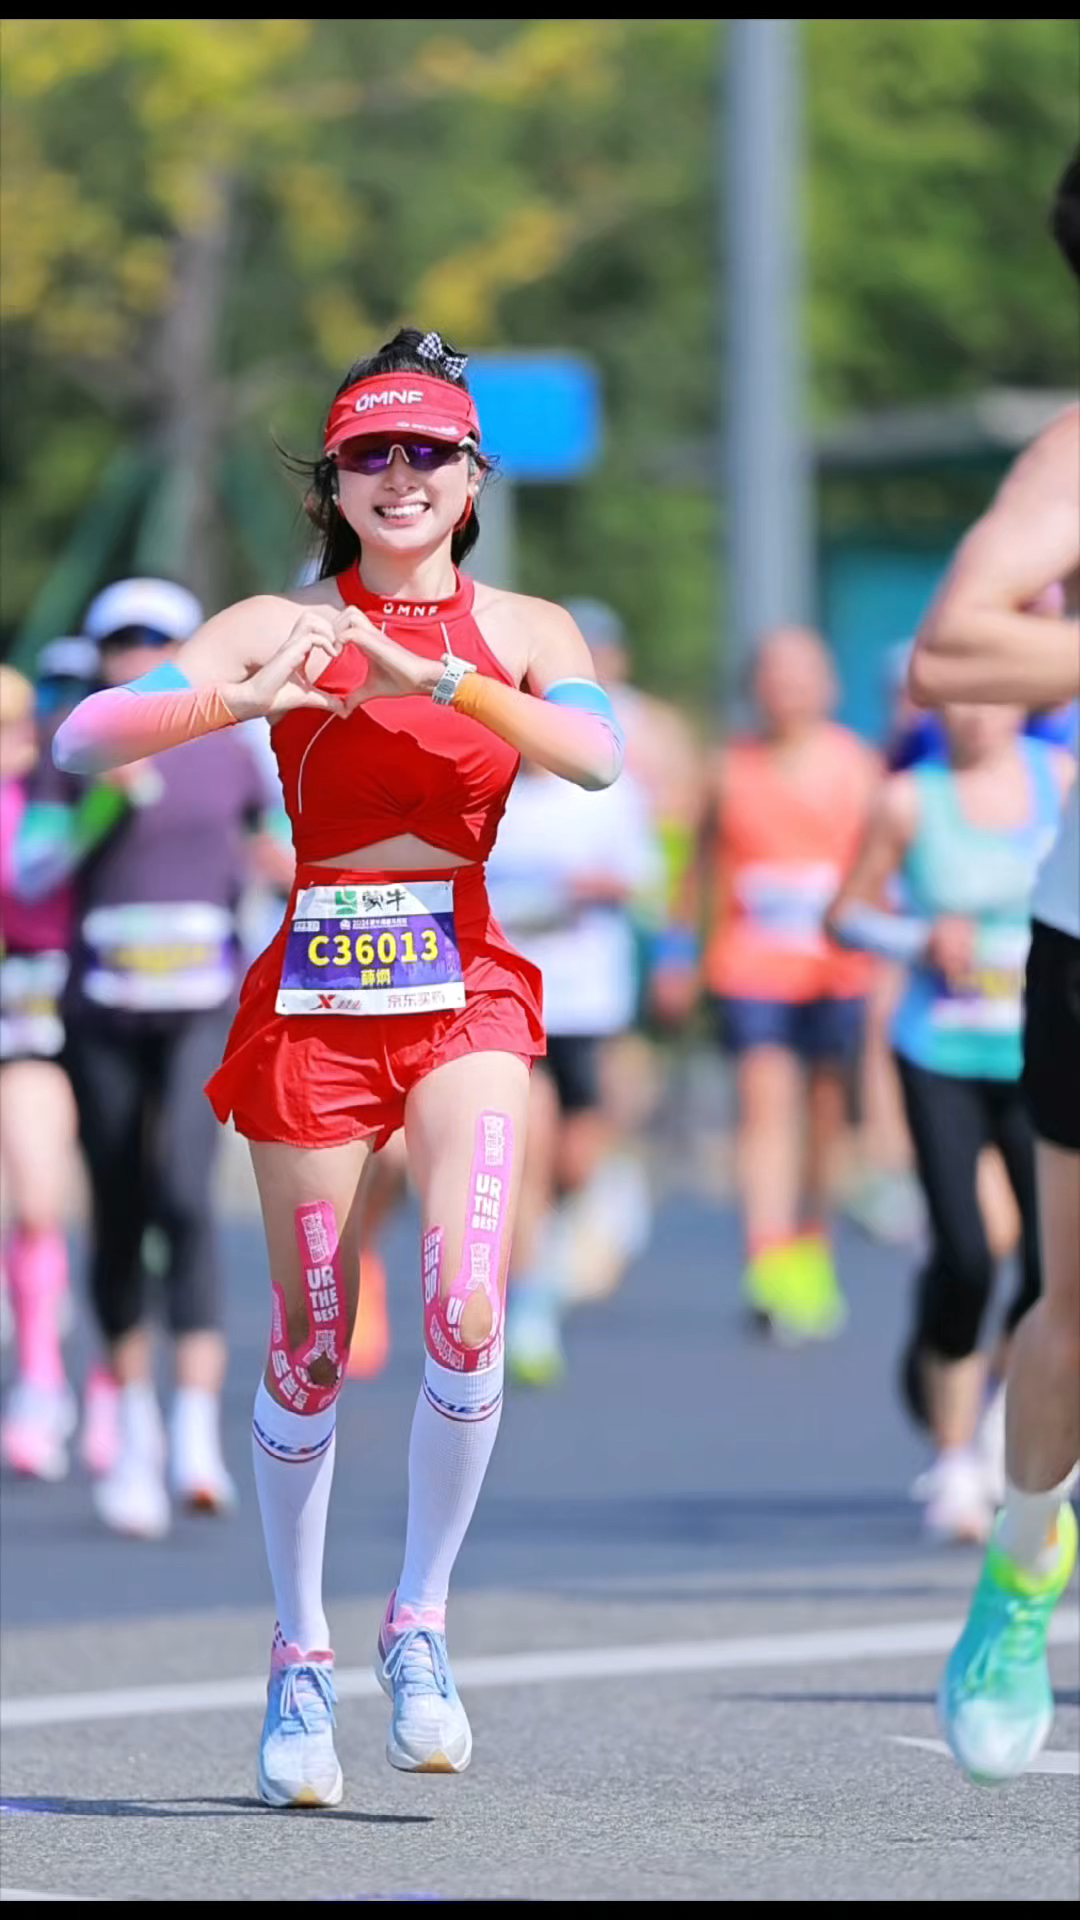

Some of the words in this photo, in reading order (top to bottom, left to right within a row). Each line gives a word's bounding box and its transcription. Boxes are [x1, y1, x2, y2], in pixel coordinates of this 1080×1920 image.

[362, 889, 406, 912] 蒙牛
[307, 929, 439, 966] C36013
[476, 1172, 502, 1199] UR
[474, 1195, 500, 1218] THE
[471, 1215, 498, 1232] BEST
[307, 1265, 335, 1289] UR
[309, 1286, 338, 1308] THE
[313, 1305, 339, 1323] BEST
